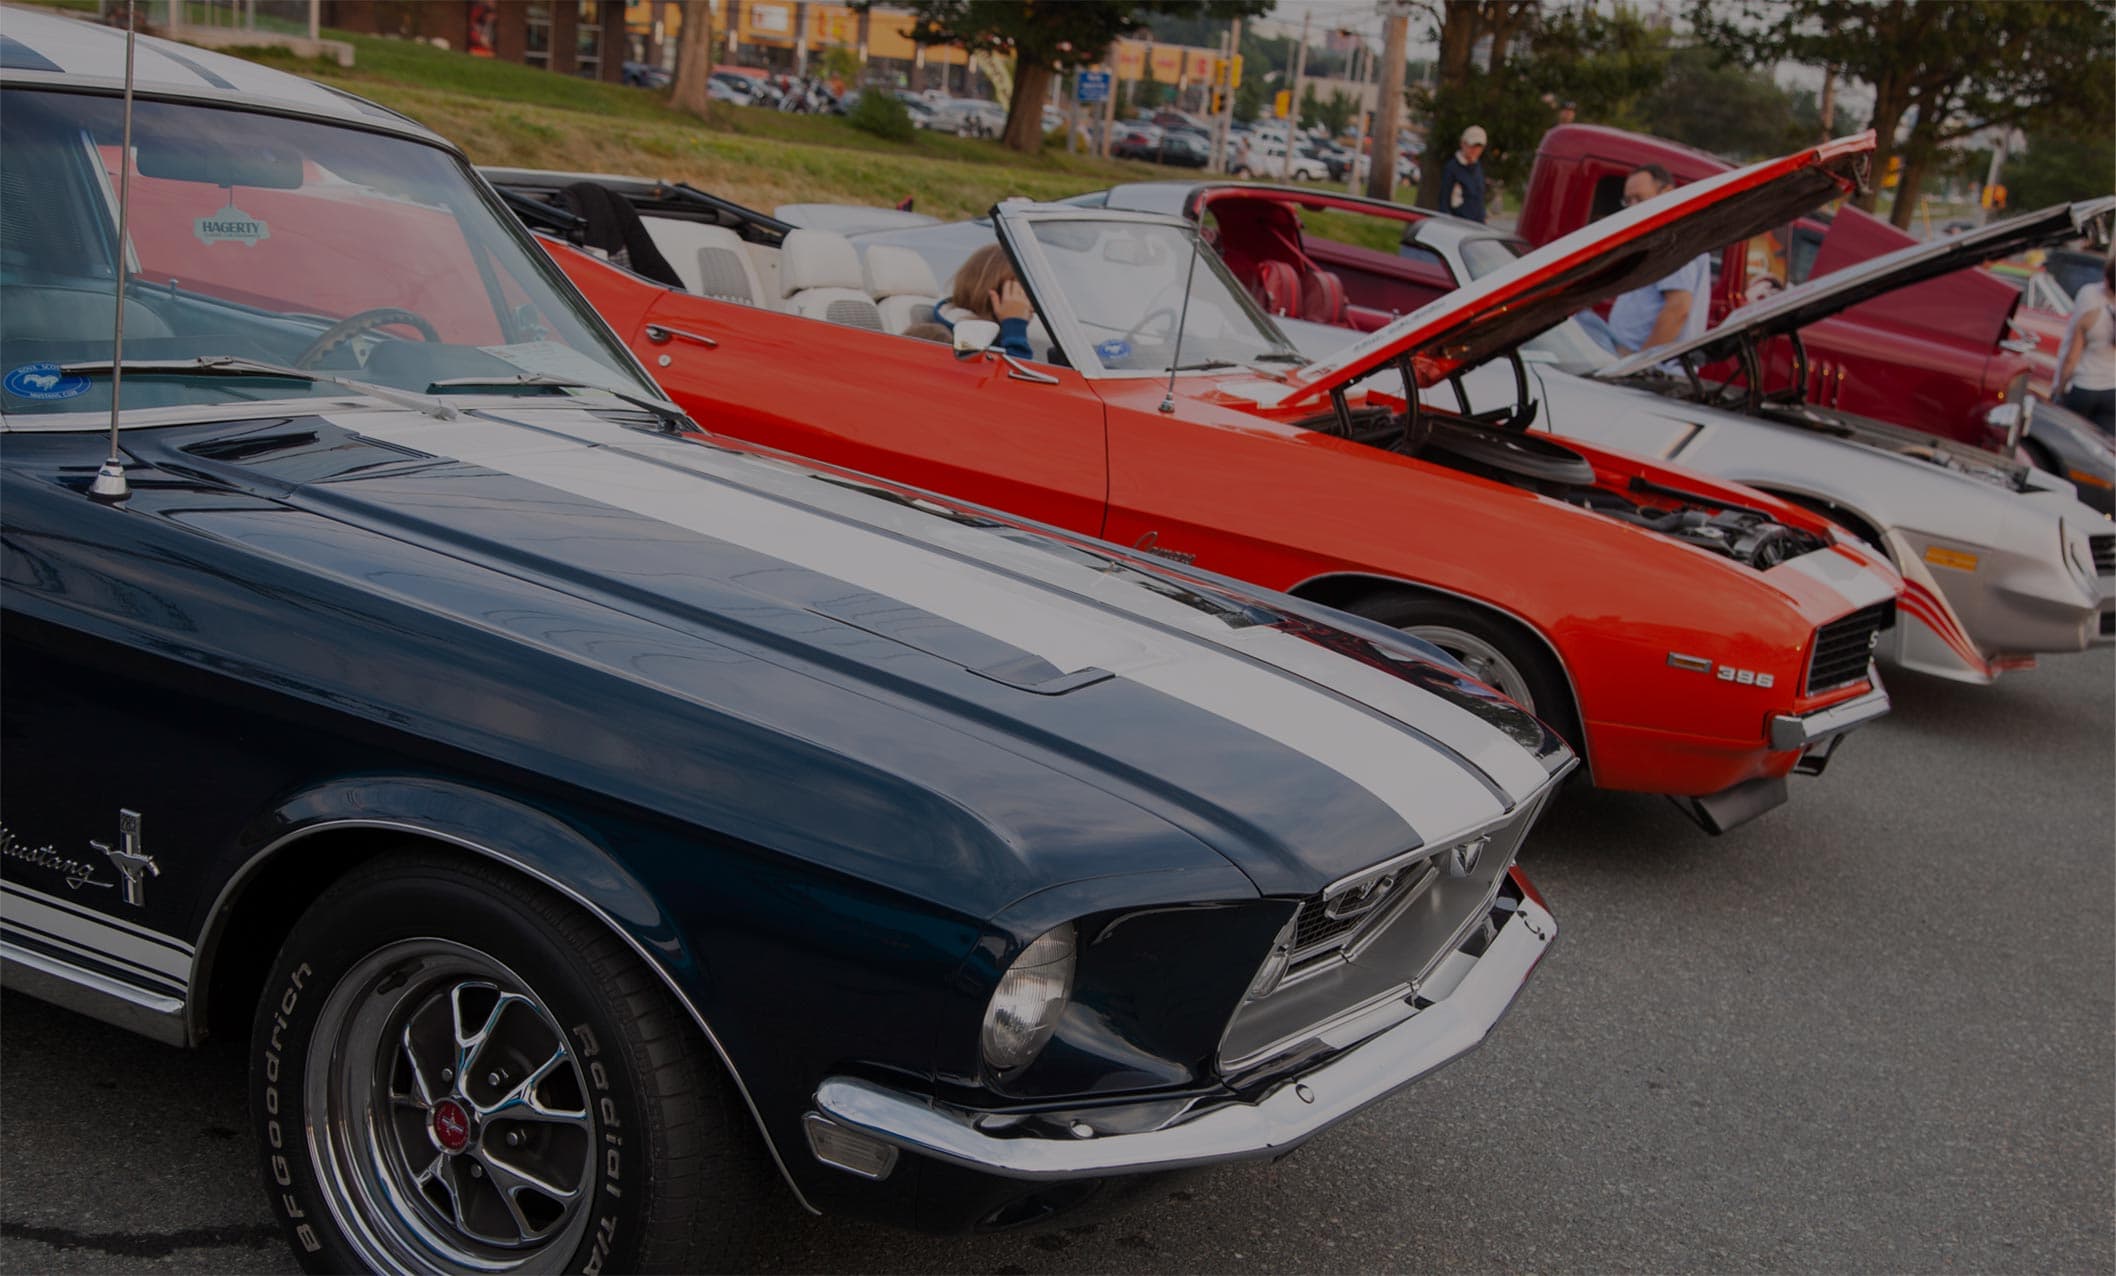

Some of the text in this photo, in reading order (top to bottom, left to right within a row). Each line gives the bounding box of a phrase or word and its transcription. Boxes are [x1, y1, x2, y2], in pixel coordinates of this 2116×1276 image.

[202, 220, 260, 234] HAGERTY
[264, 962, 321, 1254] BFGoodrich
[573, 1023, 623, 1199] Radial
